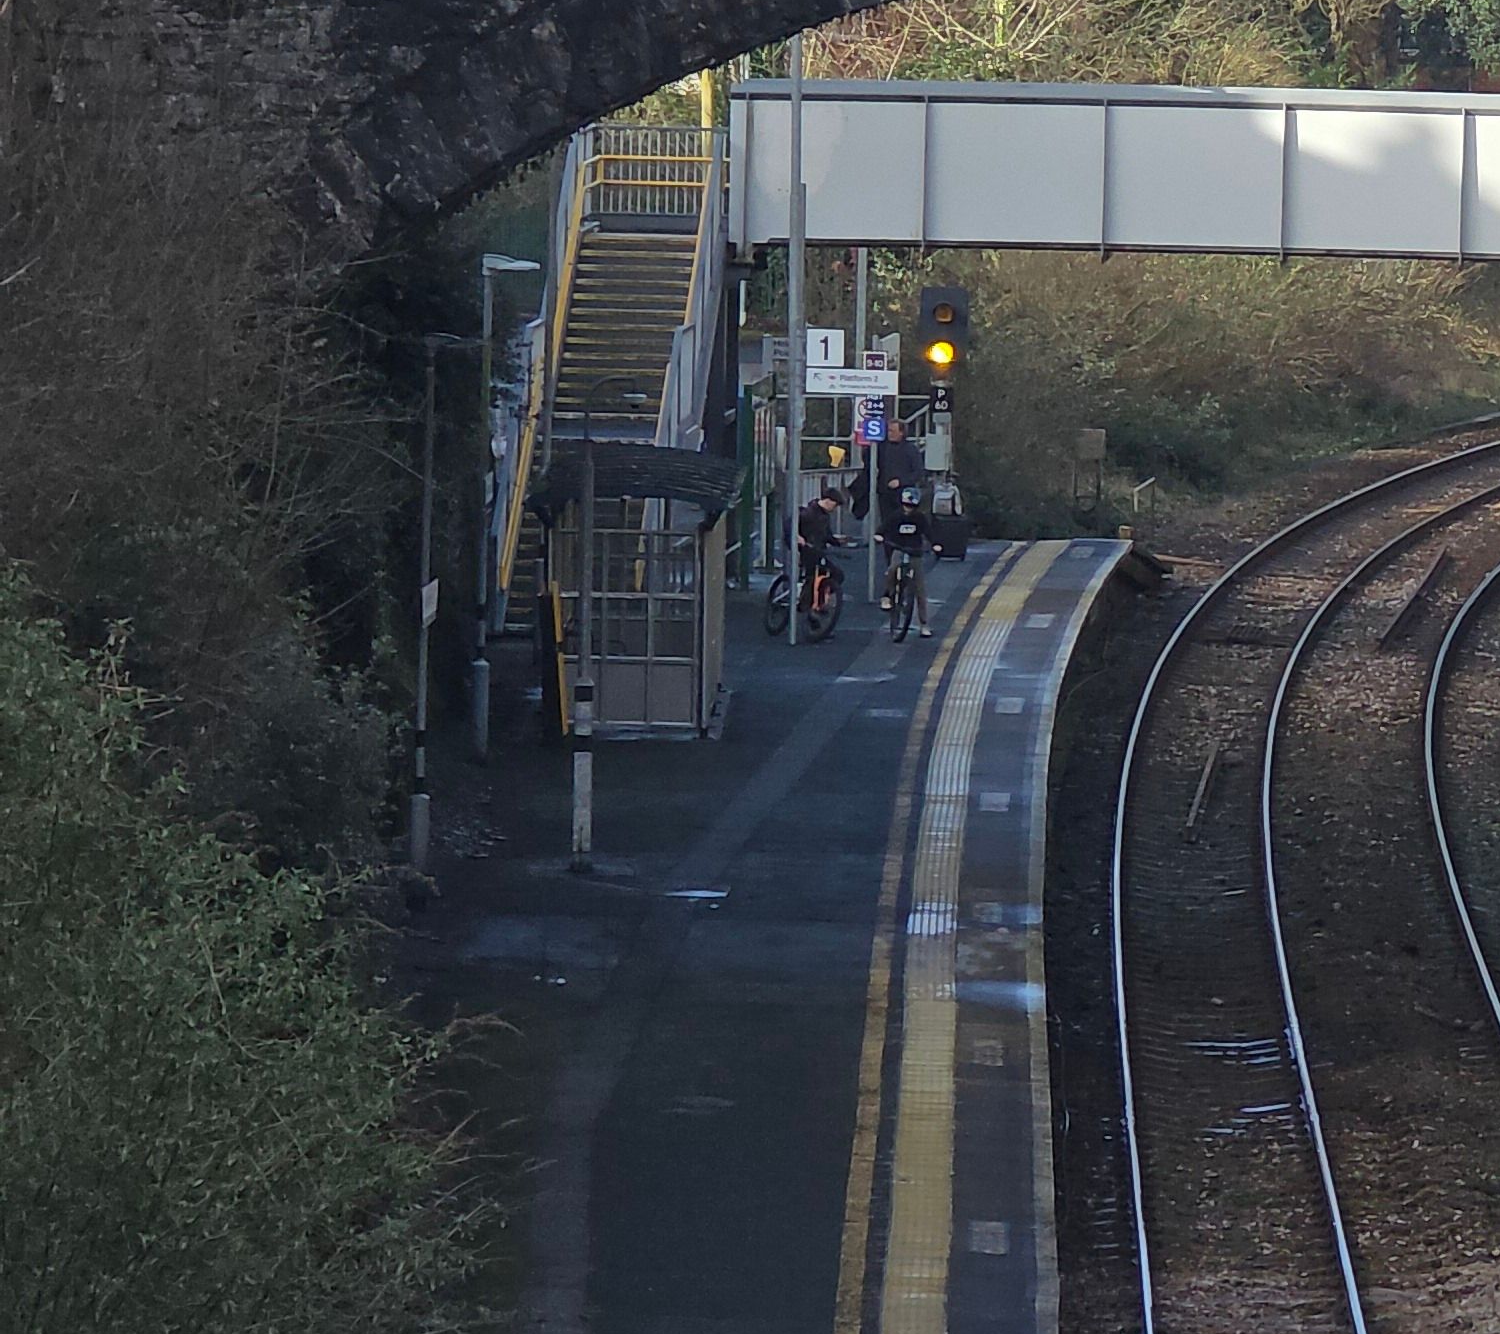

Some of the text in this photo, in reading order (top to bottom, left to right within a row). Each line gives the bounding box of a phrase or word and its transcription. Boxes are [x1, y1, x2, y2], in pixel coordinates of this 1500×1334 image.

[819, 336, 829, 360] 1
[937, 389, 946, 398] P
[934, 401, 949, 410] 60
[867, 421, 881, 435] S
